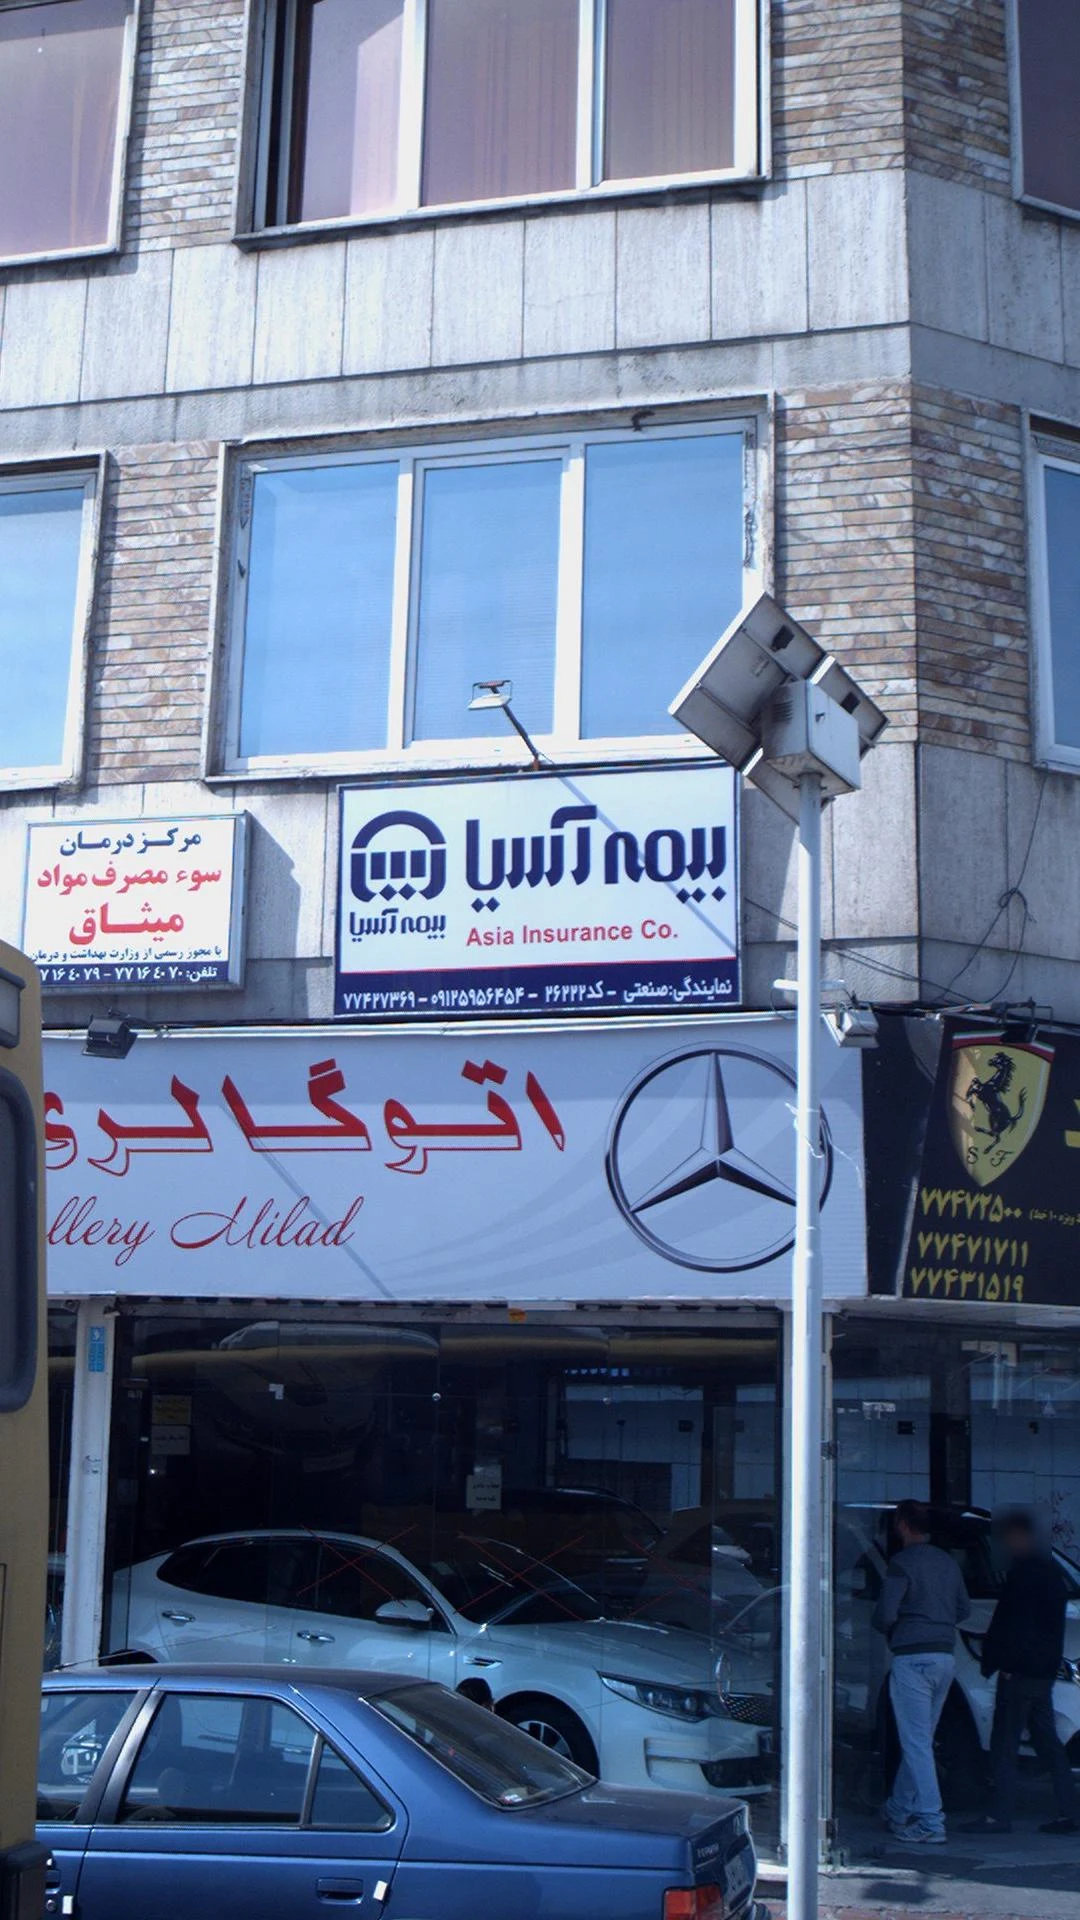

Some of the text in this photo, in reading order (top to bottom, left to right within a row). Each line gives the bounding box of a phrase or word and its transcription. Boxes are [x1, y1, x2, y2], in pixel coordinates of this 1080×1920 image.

[60, 828, 201, 856] مرکز درمان
[465, 804, 727, 913] بیمه آسیا
[37, 861, 222, 895] سوء مصرف مواد
[69, 901, 184, 945] میثاق
[349, 907, 446, 942] بیمه آسیا
[466, 919, 679, 946] Asia Insurance Co.
[70, 948, 107, 960] بهداشت
[110, 947, 139, 960] وزارت
[186, 946, 212, 959] مجوز
[46, 1195, 364, 1267] llery Milad
[918, 1231, 1028, 1268] ۷۷۴۷۱۷۱۱
